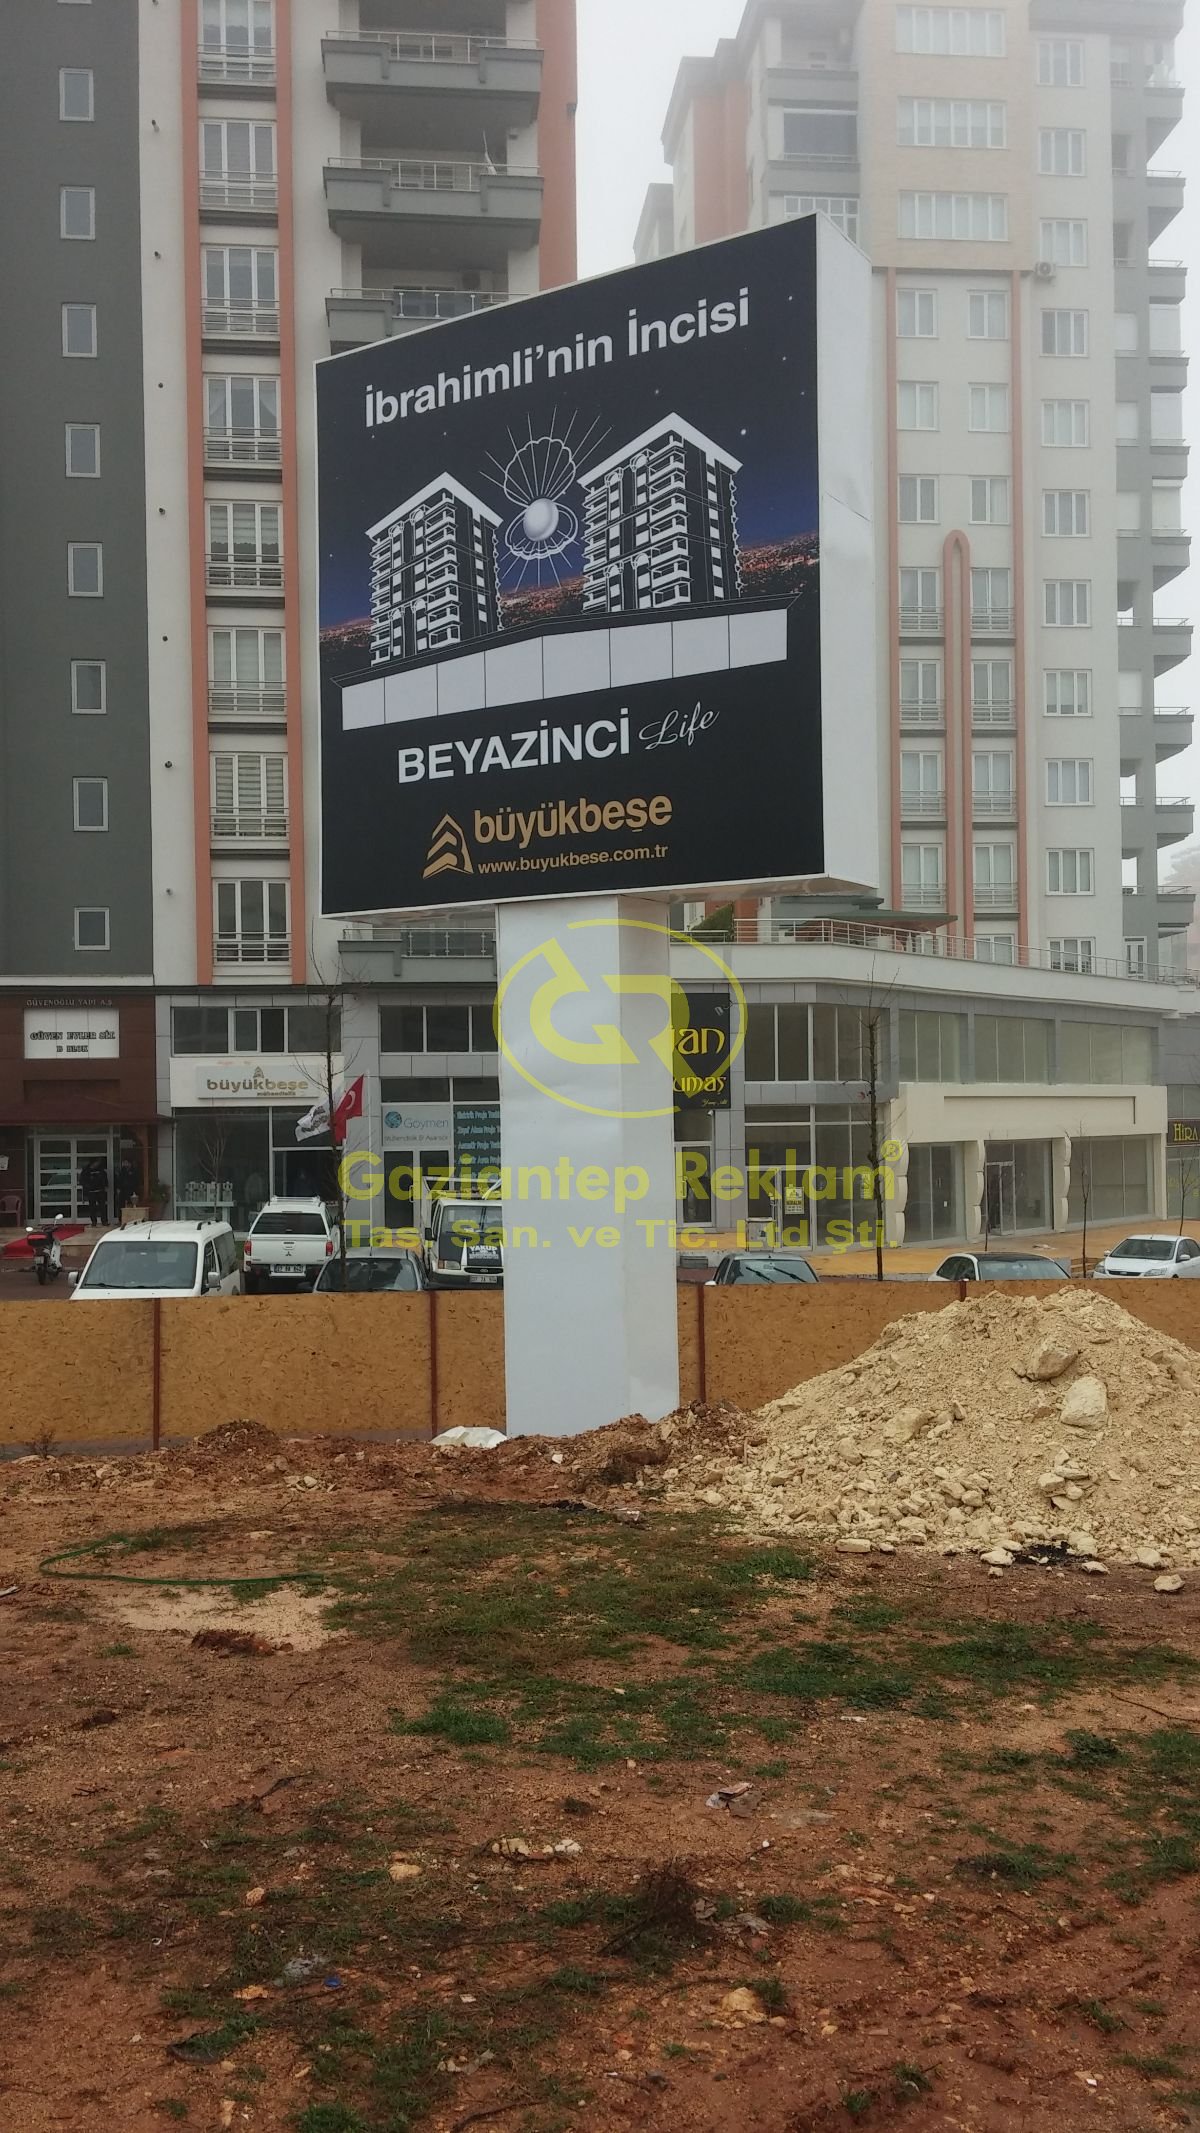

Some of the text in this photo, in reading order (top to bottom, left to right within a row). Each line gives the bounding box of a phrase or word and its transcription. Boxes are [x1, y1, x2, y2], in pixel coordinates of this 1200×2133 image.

[366, 287, 749, 427] İbrahimli'nin İncisi
[398, 701, 720, 783] BEYAZİNCİ Life
[473, 795, 673, 850] büyükbeşe
[477, 844, 669, 874] www.buyukbese.com.tr
[30, 1030, 63, 1041] GÜVEN
[66, 1045, 89, 1053] BLOK
[206, 1079, 309, 1093] büyükbeşe
